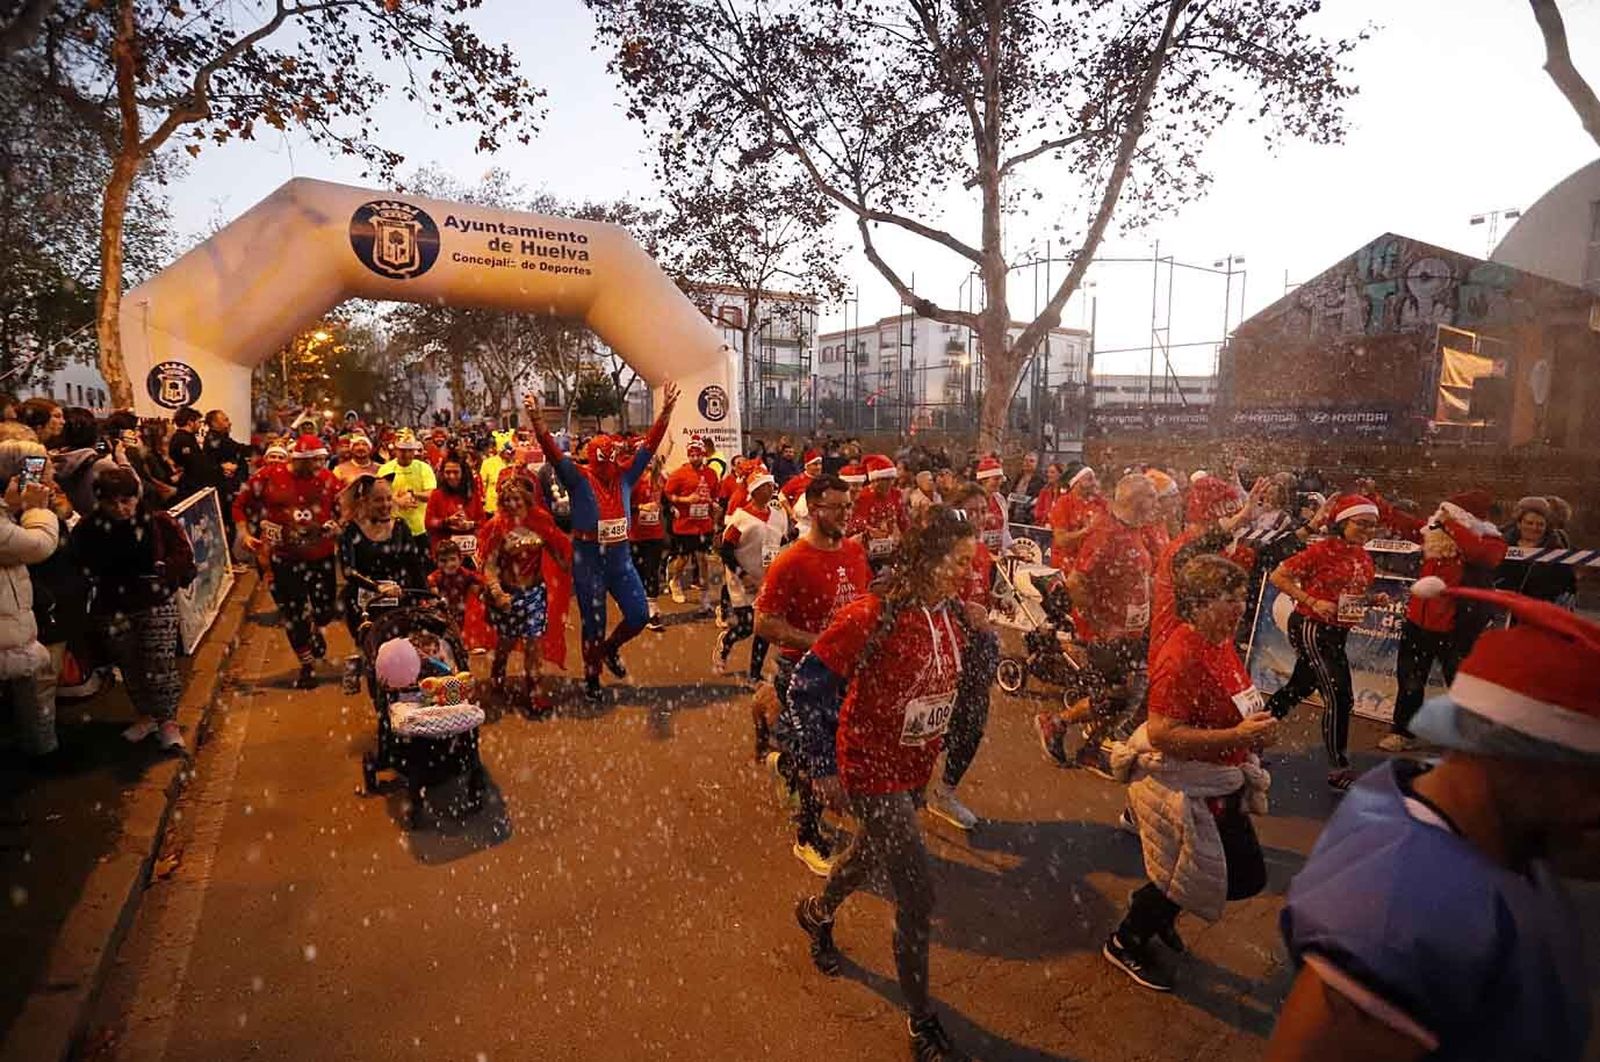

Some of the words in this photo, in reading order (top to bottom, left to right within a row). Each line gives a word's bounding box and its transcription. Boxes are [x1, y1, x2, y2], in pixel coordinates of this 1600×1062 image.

[444, 215, 588, 245] Ayuntamiento
[488, 237, 513, 252] de
[521, 240, 589, 262] Huelva
[521, 259, 536, 270] de
[540, 262, 591, 276] Deportes
[1332, 412, 1388, 422] HYUNDAI
[928, 705, 950, 728] 409
